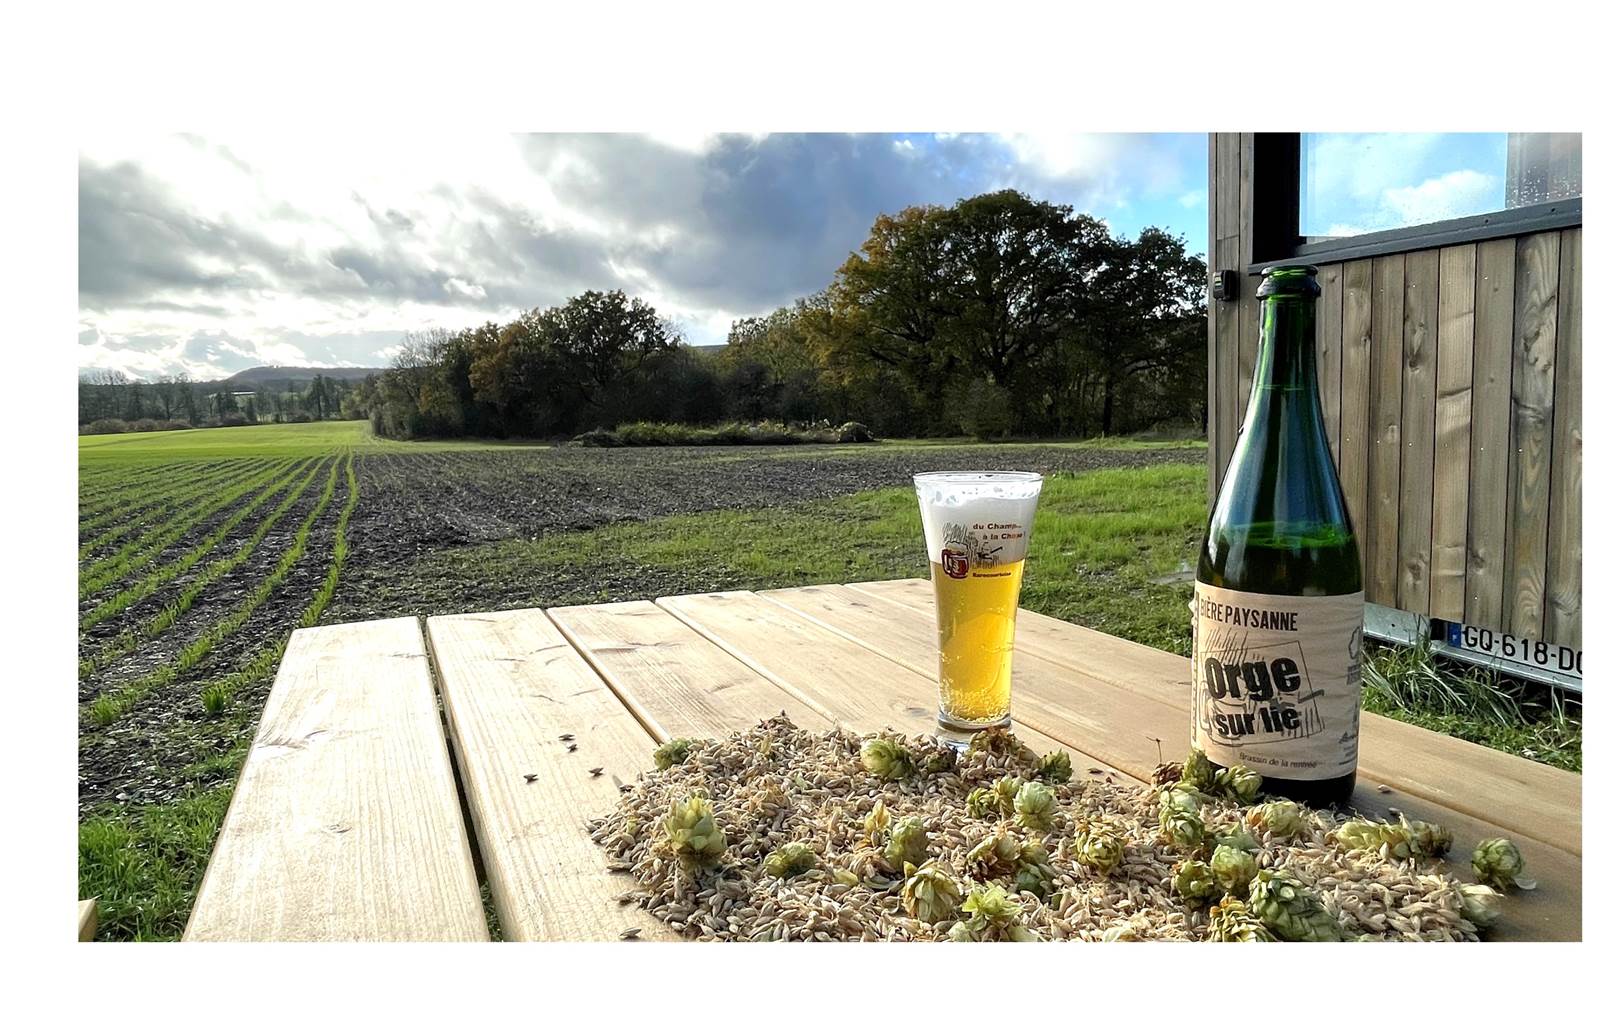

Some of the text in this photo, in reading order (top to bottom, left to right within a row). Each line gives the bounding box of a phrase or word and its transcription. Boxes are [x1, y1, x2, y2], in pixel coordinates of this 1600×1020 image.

[1200, 596, 1298, 631] BIÈRE PAYSANNE
[1205, 657, 1301, 702] Orge
[1216, 706, 1301, 736] sur lie
[1239, 752, 1267, 764] Brassin
[1269, 758, 1280, 766] de
[1281, 759, 1289, 767] la
